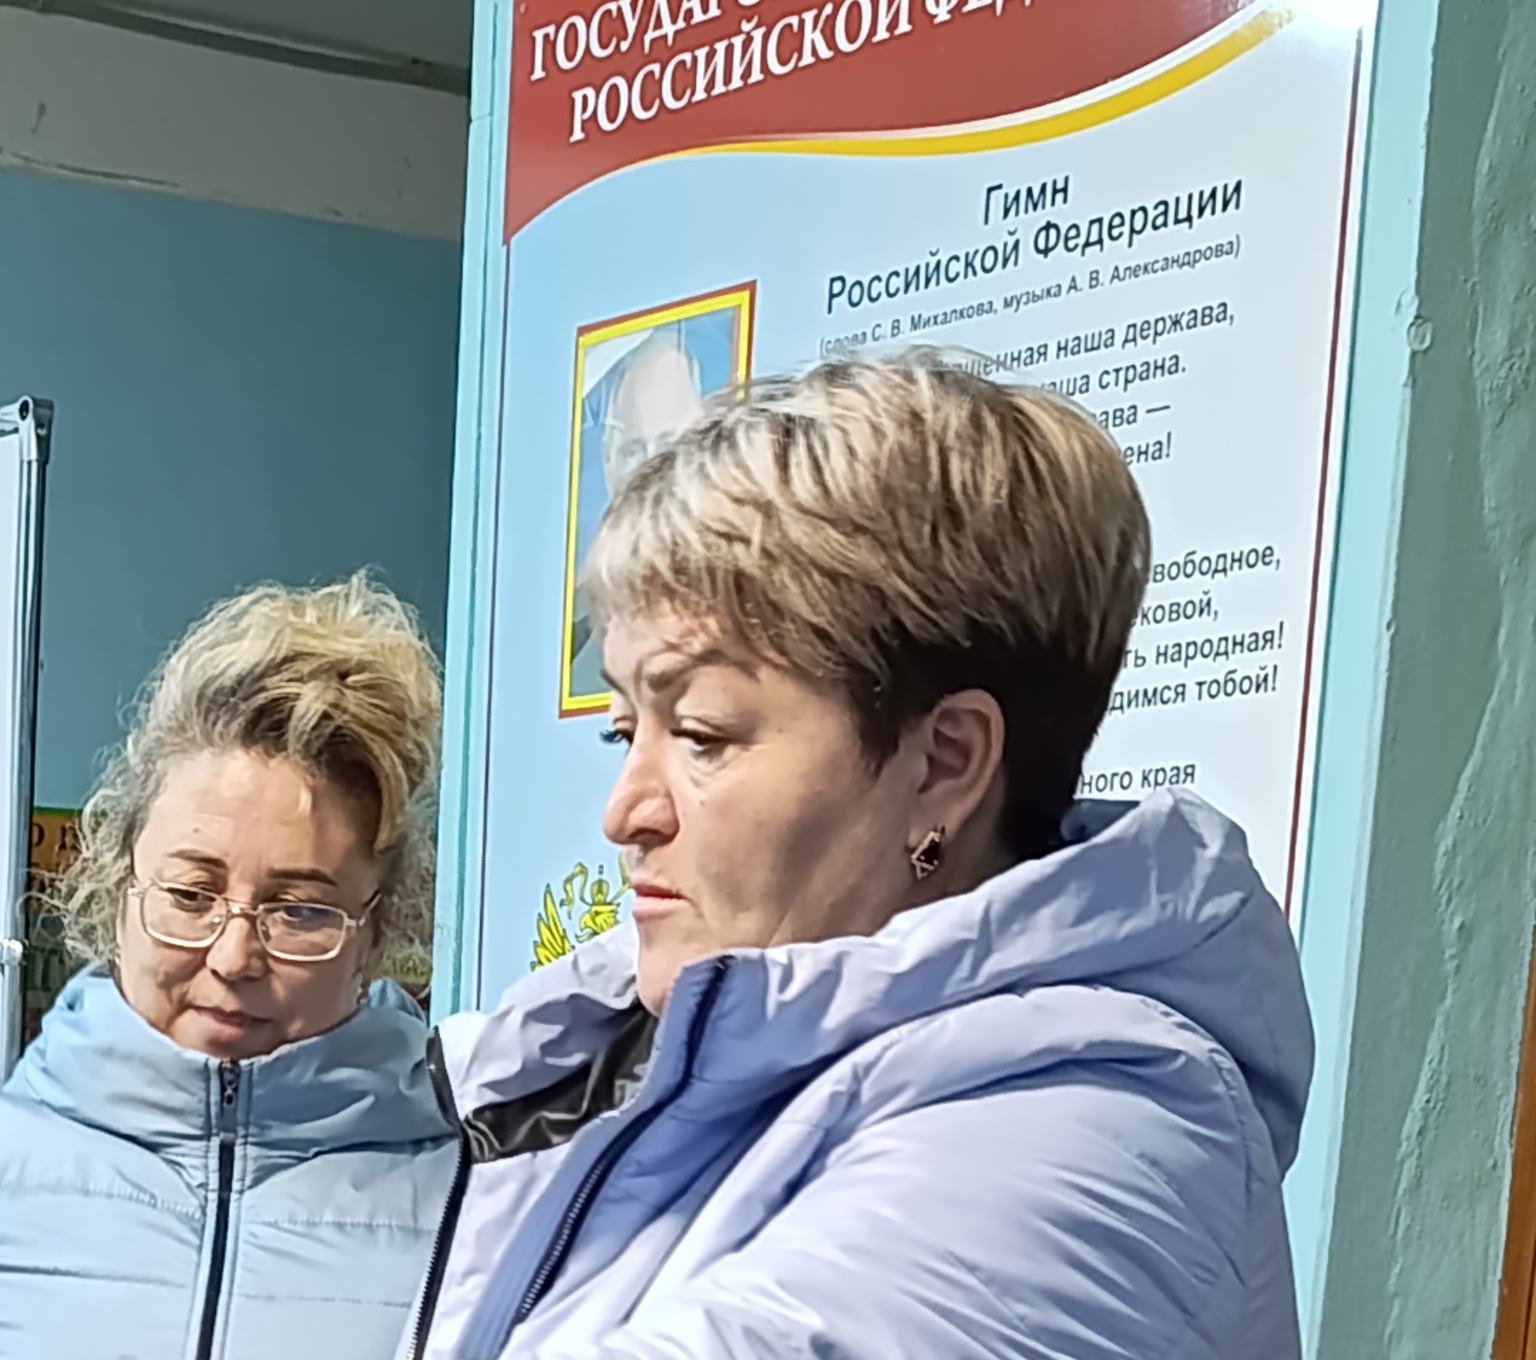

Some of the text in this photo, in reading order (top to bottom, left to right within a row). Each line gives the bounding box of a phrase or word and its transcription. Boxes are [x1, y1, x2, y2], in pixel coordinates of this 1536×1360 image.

[983, 175, 1070, 226] Гимн
[827, 179, 1243, 314] Российской Федерации
[871, 324, 886, 342] С.
[891, 319, 905, 338] В.
[910, 299, 998, 332] Михалкова,
[1002, 282, 1062, 313] музыка
[1066, 272, 1084, 295] А.
[1088, 270, 1105, 290] В.
[1109, 234, 1241, 283] Александрова)
[1055, 328, 1115, 360] наша
[1122, 301, 1235, 346] держава,
[1097, 353, 1186, 393] страна.
[1097, 404, 1138, 429] ава
[1123, 431, 1172, 466] ена!
[1152, 545, 1281, 583] вободное,
[1132, 590, 1218, 627] ковой,
[1155, 621, 1284, 668] народная!
[1109, 664, 1278, 715] димся тобой!
[1080, 764, 1196, 795] ного края
